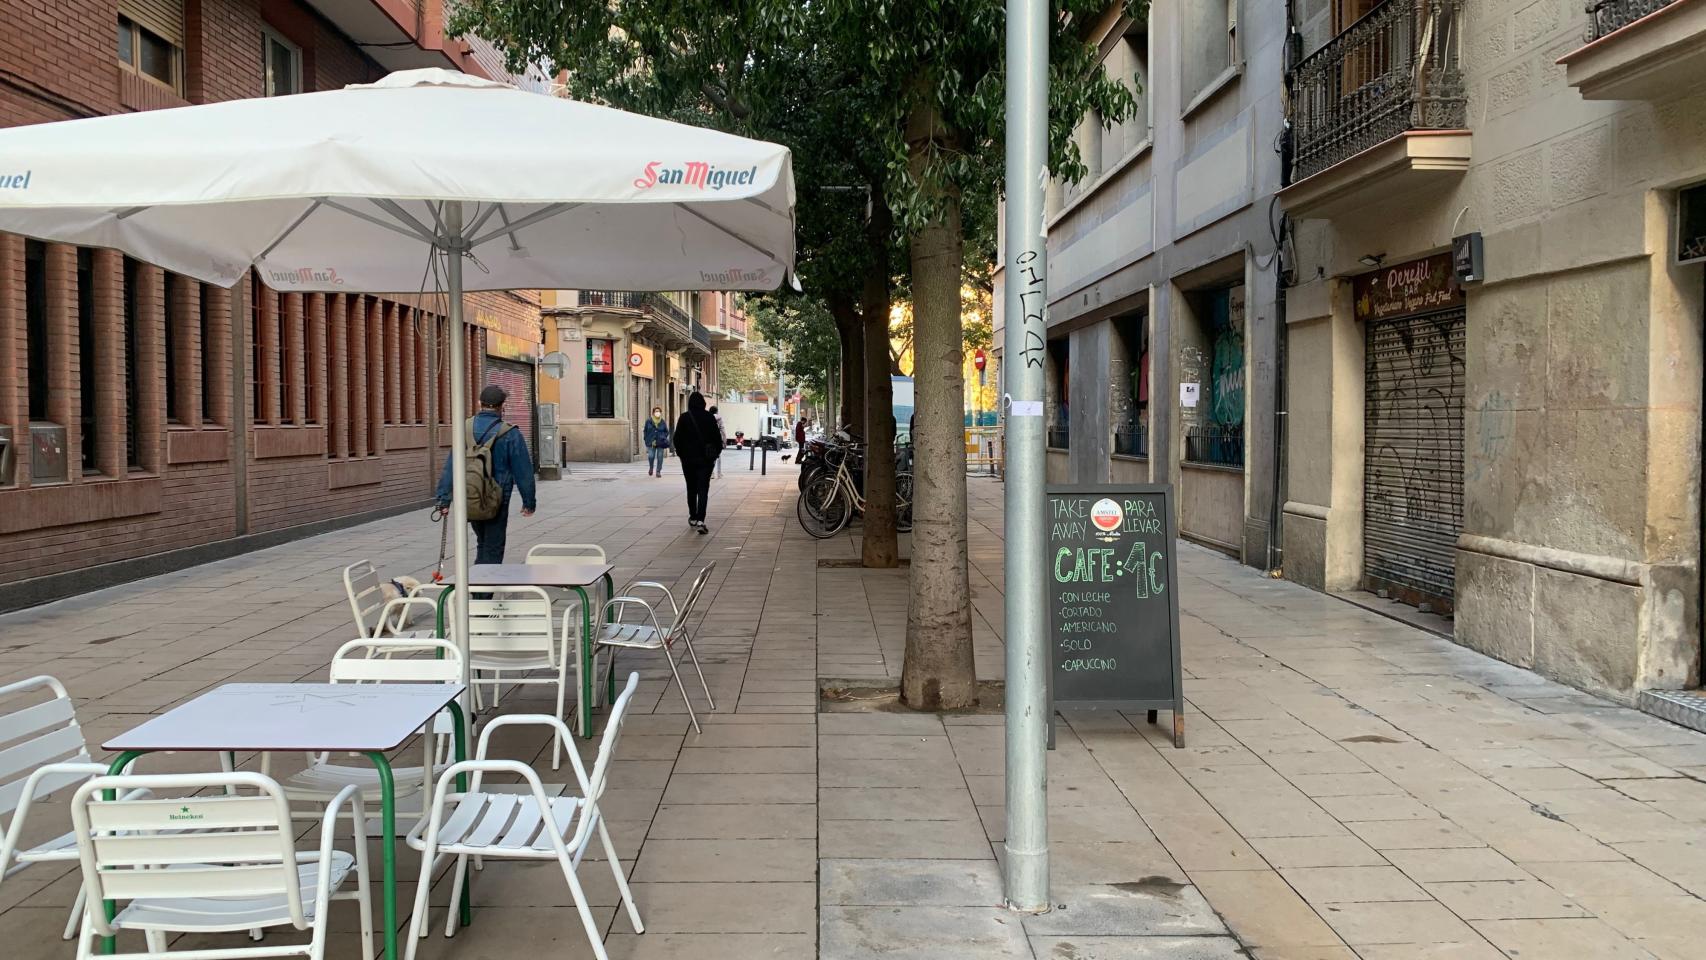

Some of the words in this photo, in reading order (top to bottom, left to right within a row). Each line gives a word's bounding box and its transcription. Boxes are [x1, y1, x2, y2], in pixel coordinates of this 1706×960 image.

[1404, 285, 1419, 297] BAR
[1050, 499, 1089, 519] TAKE
[1124, 500, 1157, 518] PARA
[1052, 521, 1087, 541] AWAY
[1122, 518, 1162, 535] LLEVAR
[1062, 592, 1080, 604] CON
[1061, 607, 1102, 619] CORTADO
[1062, 621, 1117, 633] AMERICANO
[1063, 639, 1092, 653] SOLO
